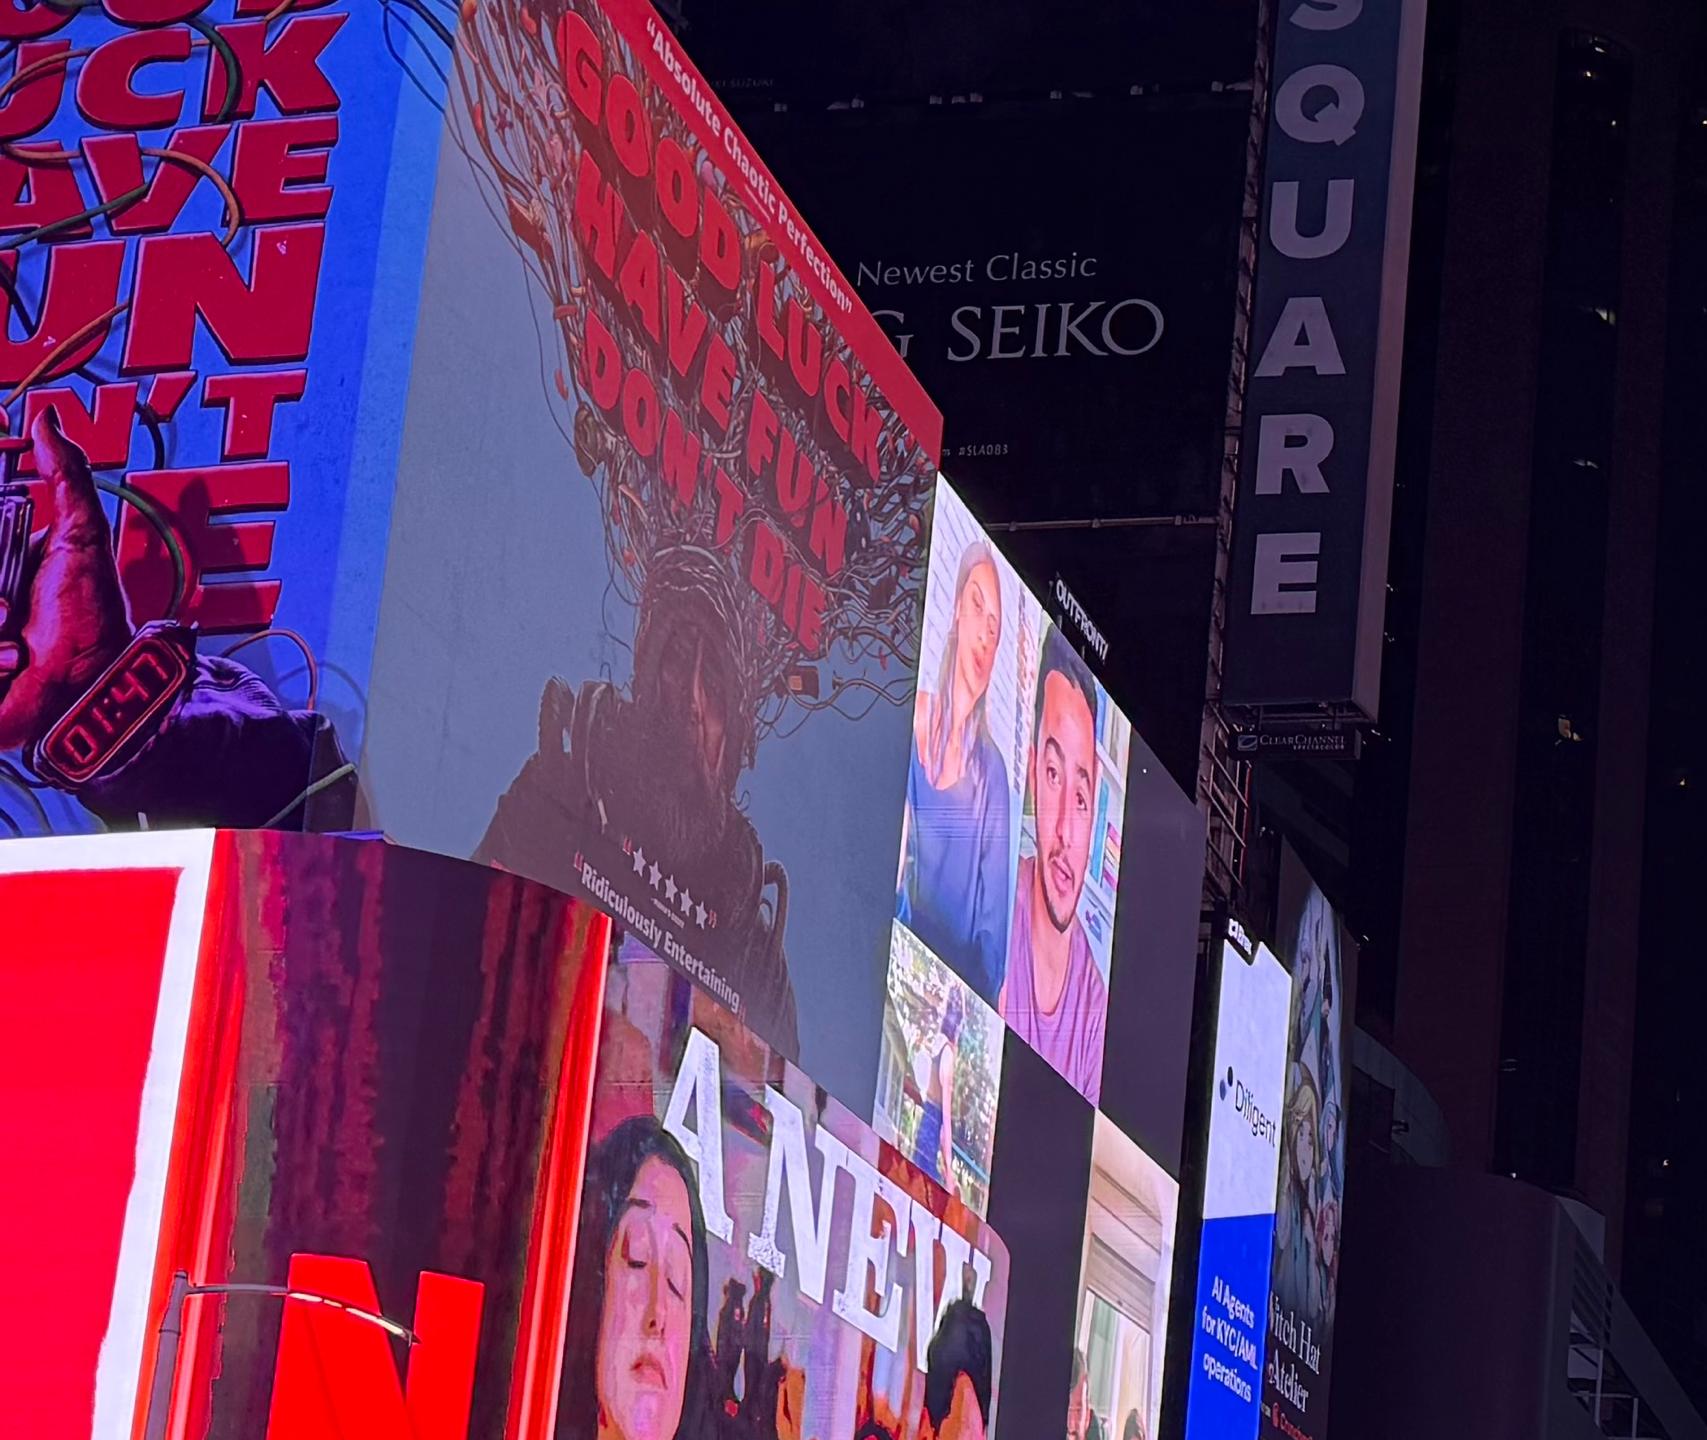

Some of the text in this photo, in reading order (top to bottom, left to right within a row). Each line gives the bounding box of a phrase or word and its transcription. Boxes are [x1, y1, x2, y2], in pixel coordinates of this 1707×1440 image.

[724, 127, 776, 213] Chaotic
[556, 10, 881, 483] GOOD LUCK
[856, 252, 1098, 288] Newest Classic
[574, 149, 848, 575] HAVE FUN
[946, 299, 1166, 363] SEIKO
[750, 521, 826, 652] DIE
[1235, 1079, 1277, 1149] Diligent
[663, 1026, 992, 1374] A NEW
[1201, 1306, 1215, 1337] for
[1211, 1275, 1255, 1330] AI Agents
[1202, 1352, 1252, 1403] operations
[1300, 1319, 1321, 1376] Hat
[1268, 1349, 1310, 1413] Atelier
